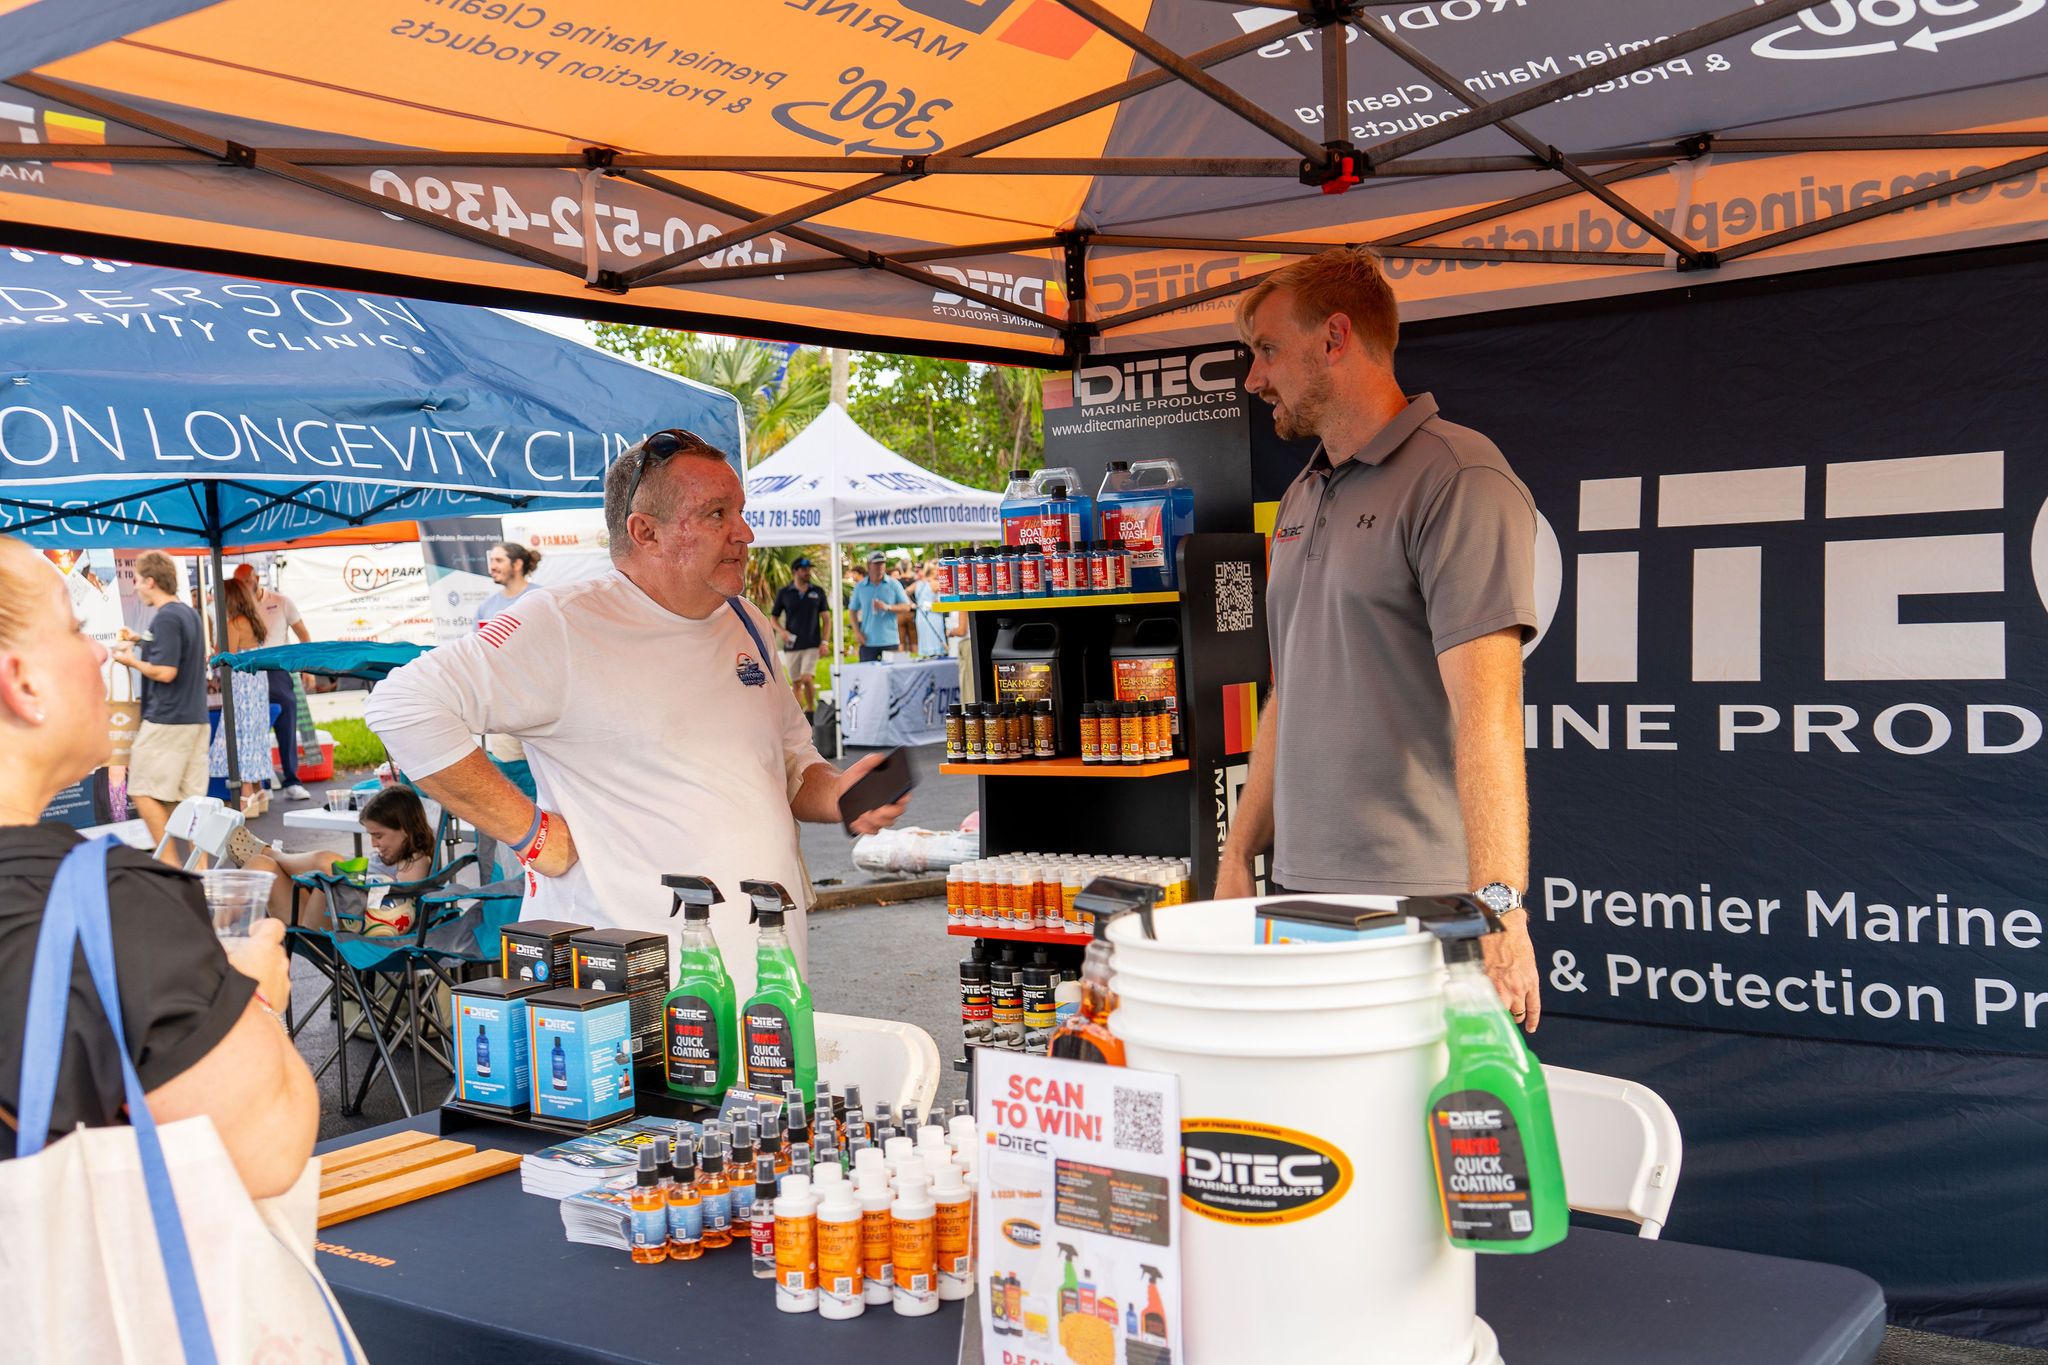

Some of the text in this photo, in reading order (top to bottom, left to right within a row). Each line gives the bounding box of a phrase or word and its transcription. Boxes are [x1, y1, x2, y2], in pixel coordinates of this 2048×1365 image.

[1081, 391, 1238, 418] MARINE PRODUCTS
[1052, 405, 1241, 437] www.ditecmarineproducts.com
[143, 407, 505, 478] LONGEVITY
[769, 508, 821, 528] 781-5600
[1120, 520, 1146, 531] BOAT
[543, 535, 579, 545] YAMAHA
[1118, 530, 1147, 540] WASH
[999, 679, 1045, 688] TEAK MAGIC
[1543, 876, 2042, 948] Premier Marine
[1549, 949, 1588, 993] &
[1605, 952, 1945, 1023] Protection
[973, 1008, 990, 1017] CUT
[676, 1036, 704, 1048] QUICK
[753, 1045, 781, 1056] QUICK
[672, 1046, 710, 1058] COATING
[750, 1055, 787, 1067] COATING
[1008, 1073, 1085, 1110] SCAN
[992, 1099, 1103, 1142] TO WIN!
[1454, 1156, 1504, 1175] QUICK
[1187, 1177, 1325, 1197] MARINE PRODUCTS
[1450, 1174, 1517, 1192] COATING
